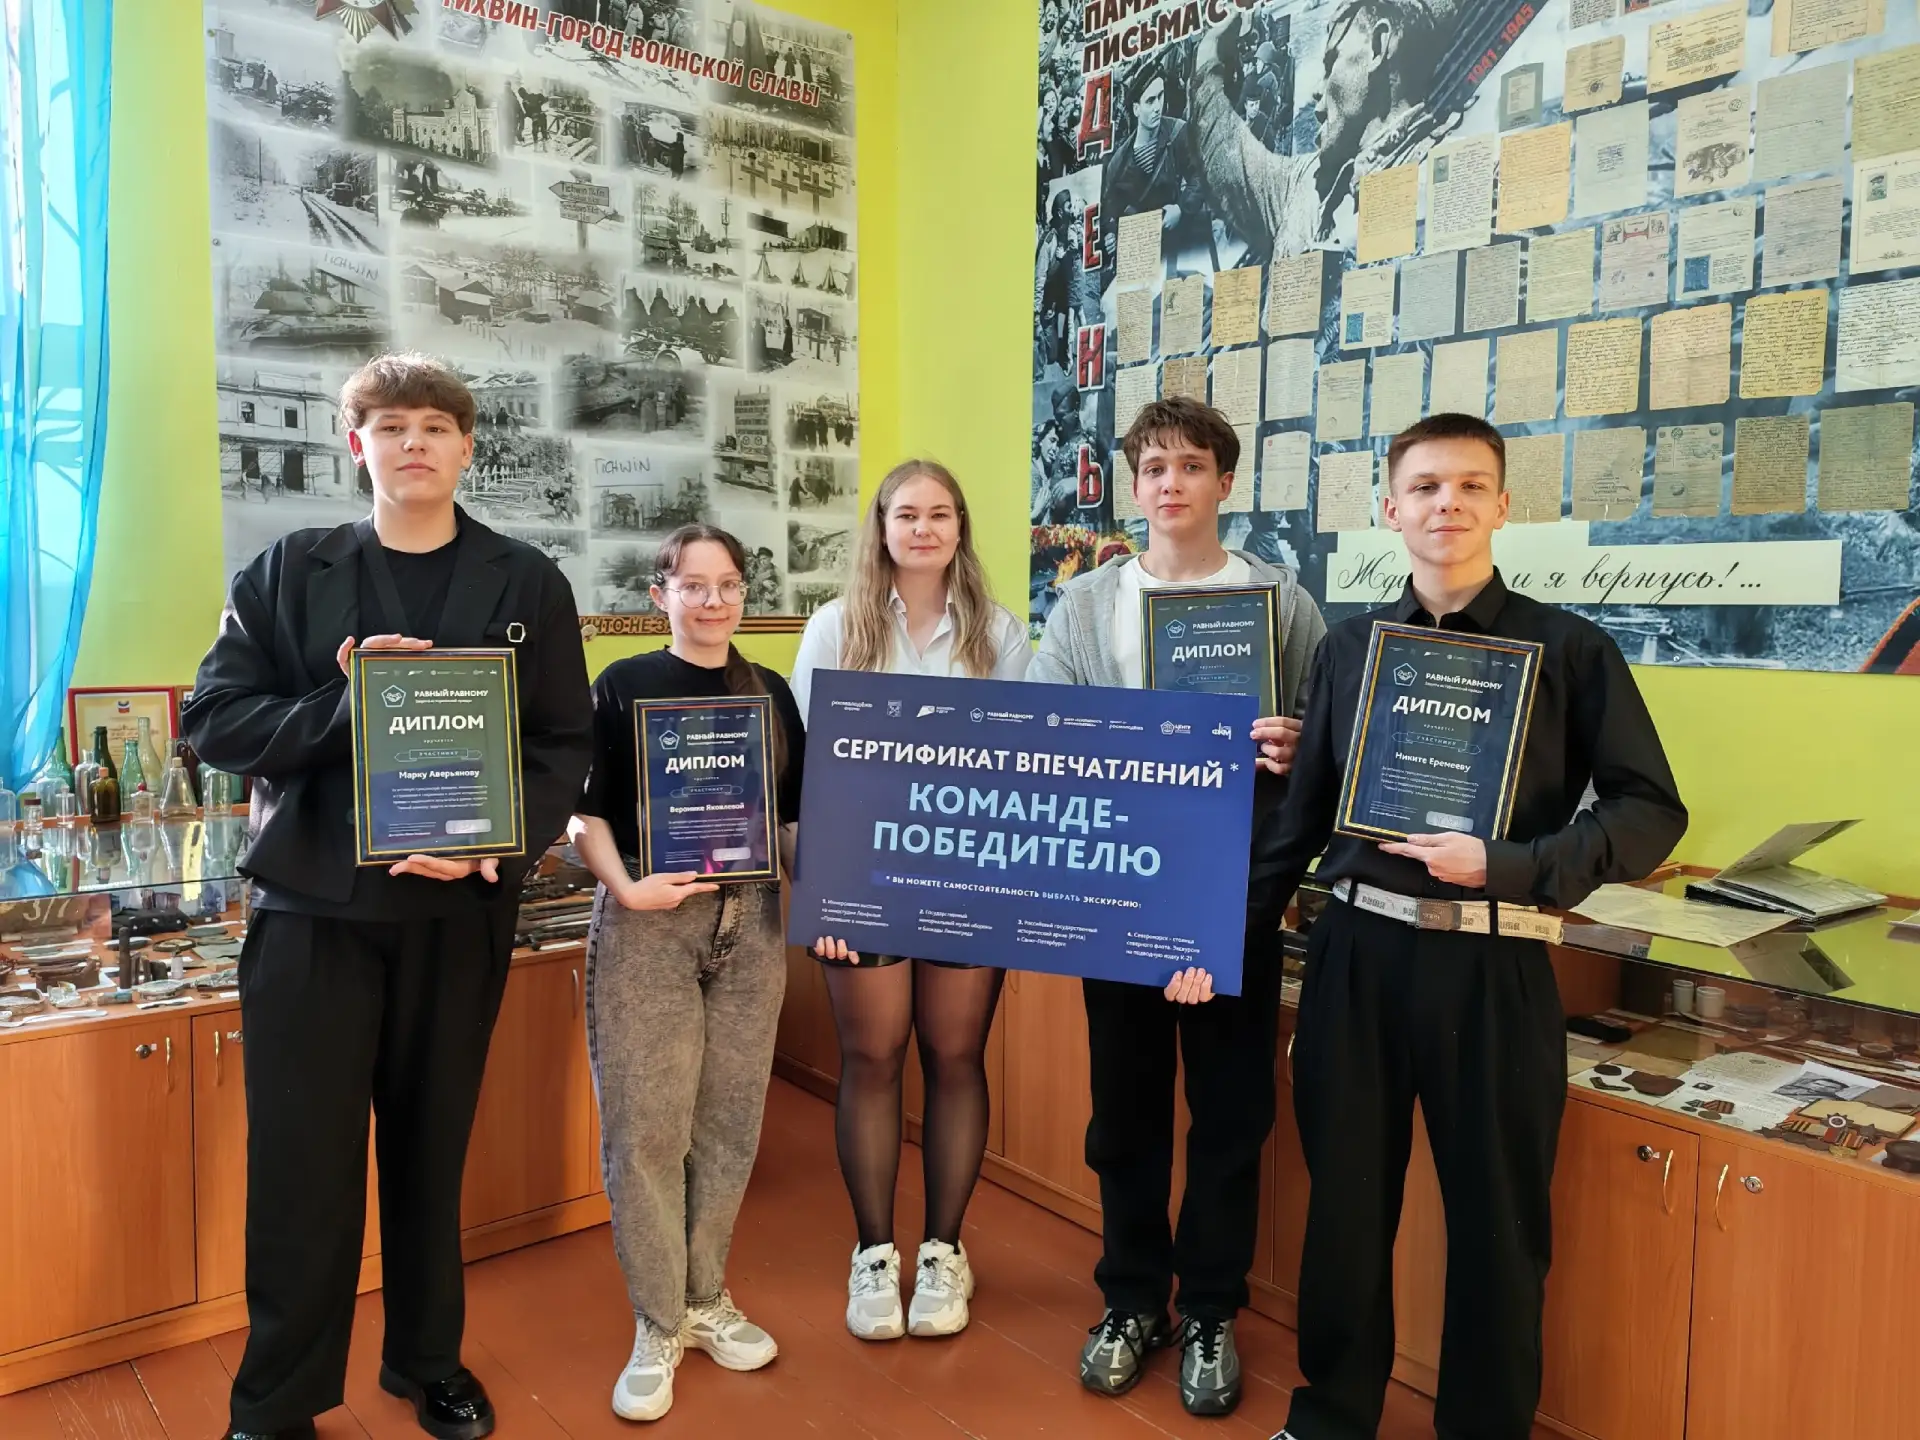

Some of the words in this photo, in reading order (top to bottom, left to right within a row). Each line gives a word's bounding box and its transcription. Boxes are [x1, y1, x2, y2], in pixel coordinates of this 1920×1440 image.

[1499, 3, 1536, 44] 1945
[1082, 0, 1202, 74] ПИСЬМА
[442, 0, 625, 59] ИХВИН-ГОРОД
[630, 35, 745, 87] ВОИНСКОЙ
[748, 68, 821, 107] СЛАВЫ
[1464, 48, 1498, 84] 1941
[1543, 574, 1568, 589] я
[1581, 552, 1740, 606] вернусь!
[1192, 621, 1221, 630] РАВНЫЙ
[1222, 620, 1255, 629] РАВНОМУ
[1172, 643, 1252, 663] ДИПЛОМ
[1425, 672, 1461, 685] РАВНЫЙ
[1461, 677, 1504, 690] РАВНОМУ
[414, 689, 449, 698] РАВНЫЙ
[449, 689, 489, 698] РАВНОМУ
[1392, 695, 1492, 724] ДИПЛОМ
[389, 714, 484, 735] ДИПЛОМ
[686, 732, 715, 741] РАВНЫЙ
[715, 731, 749, 740] РАВНОМУ
[665, 754, 745, 774] ДИПЛОМ
[833, 737, 1011, 771] СЕРТИФИКАТ
[1016, 751, 1223, 789] ВПЕЧАТЛЕНИЙ
[1395, 751, 1428, 765] Никите
[1429, 757, 1472, 773] Еремееву
[399, 771, 427, 780] Марку
[429, 769, 480, 780] Аверьянову
[669, 805, 705, 814] Веронике
[706, 802, 745, 811] Яковлевой
[909, 782, 1129, 835] КОМАНДЕ-
[873, 820, 1161, 877] ПОБЕДИТЕЛЮ
[892, 876, 905, 885] ВЫ
[906, 878, 942, 889] МОЖЕТЕ
[943, 882, 1040, 898] САМОСТОЯТЕЛЬНОСТЬ
[1042, 892, 1081, 902] ВЫБРАТЬ
